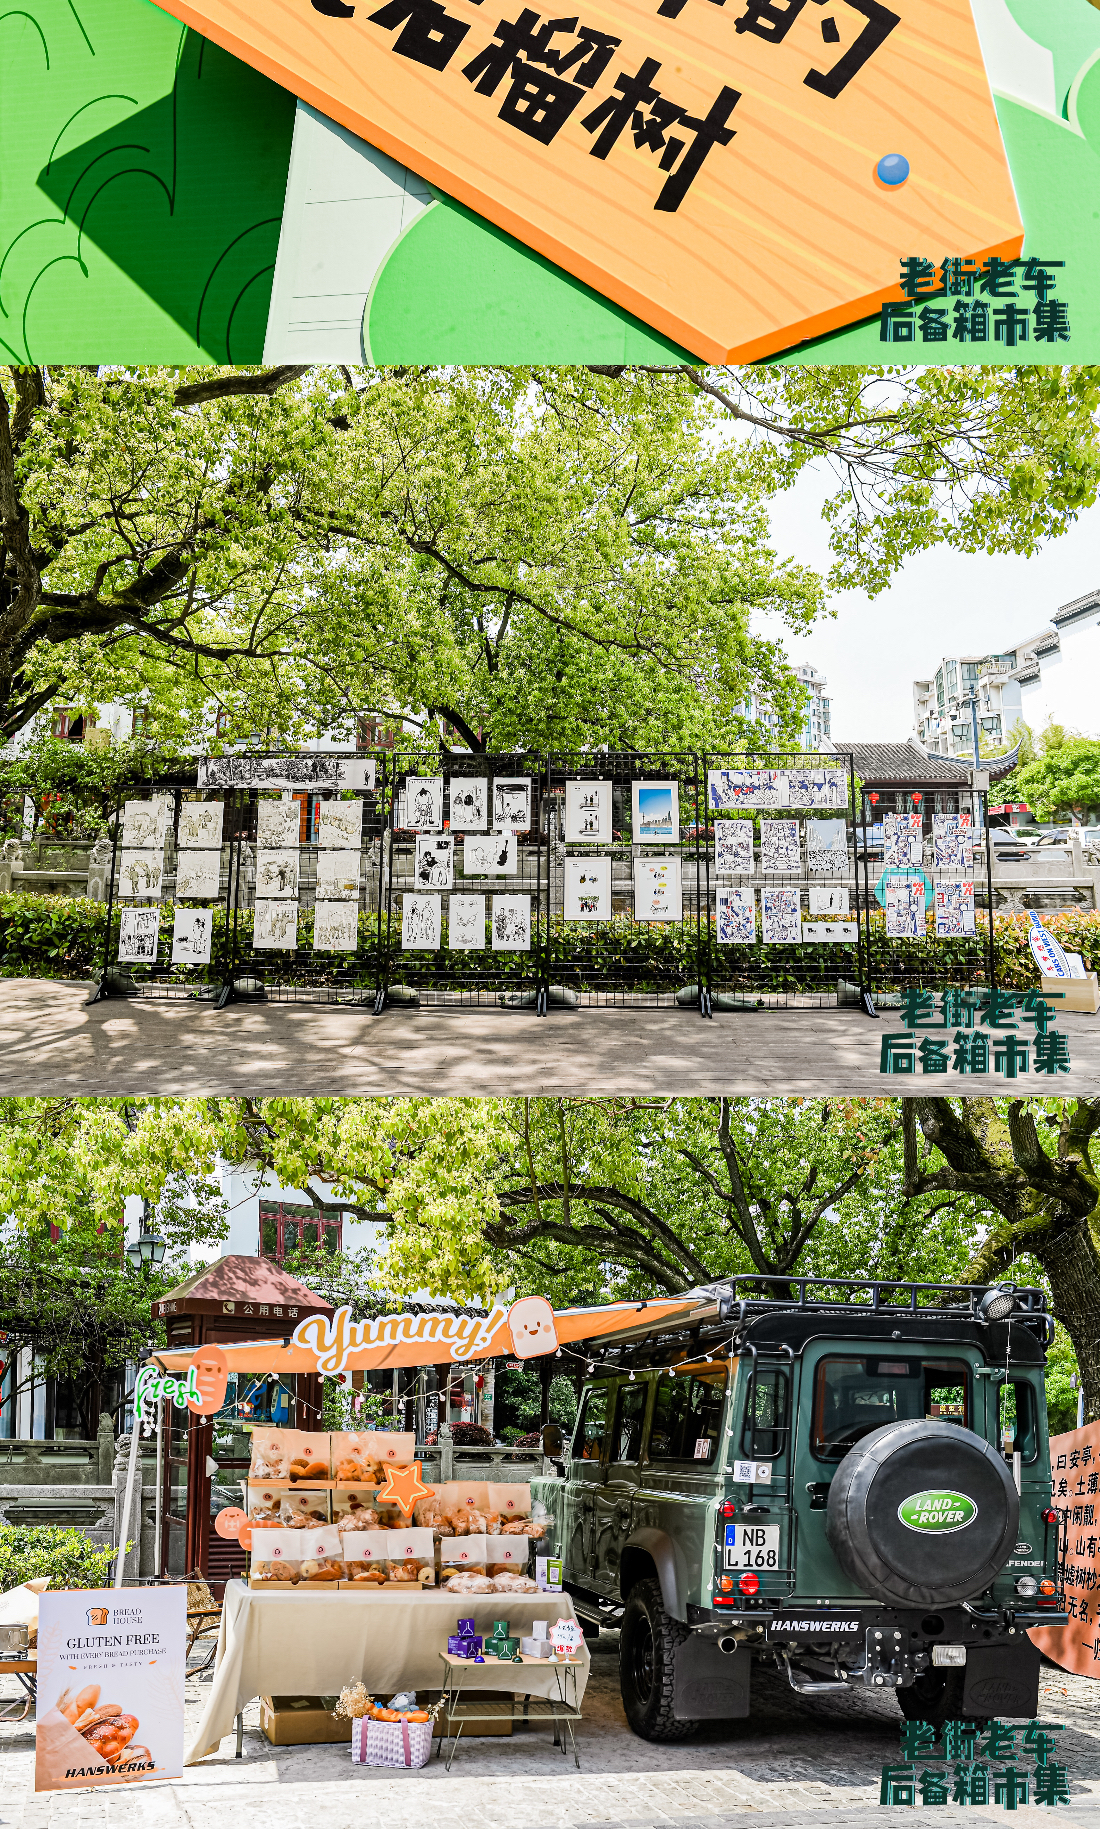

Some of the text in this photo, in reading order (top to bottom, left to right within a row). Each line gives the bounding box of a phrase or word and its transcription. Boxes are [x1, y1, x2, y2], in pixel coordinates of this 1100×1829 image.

[243, 1304, 299, 1318] 公用电话
[297, 1307, 506, 1372] Yummy!
[135, 1366, 202, 1419] fresh
[915, 1498, 952, 1511] LAND
[918, 1510, 964, 1523] ROVER
[742, 1528, 766, 1547] NB
[727, 1549, 777, 1568] L 168
[113, 1608, 142, 1617] BREAD
[113, 1616, 143, 1625] HOUSE
[770, 1620, 859, 1632] HANSWERKS
[67, 1634, 160, 1649] GLUTEN FREE
[80, 1651, 103, 1659] EVERY
[104, 1650, 128, 1658] BREAD
[130, 1648, 166, 1656] PURCHASE
[65, 1761, 156, 1778] HANSWERKS
